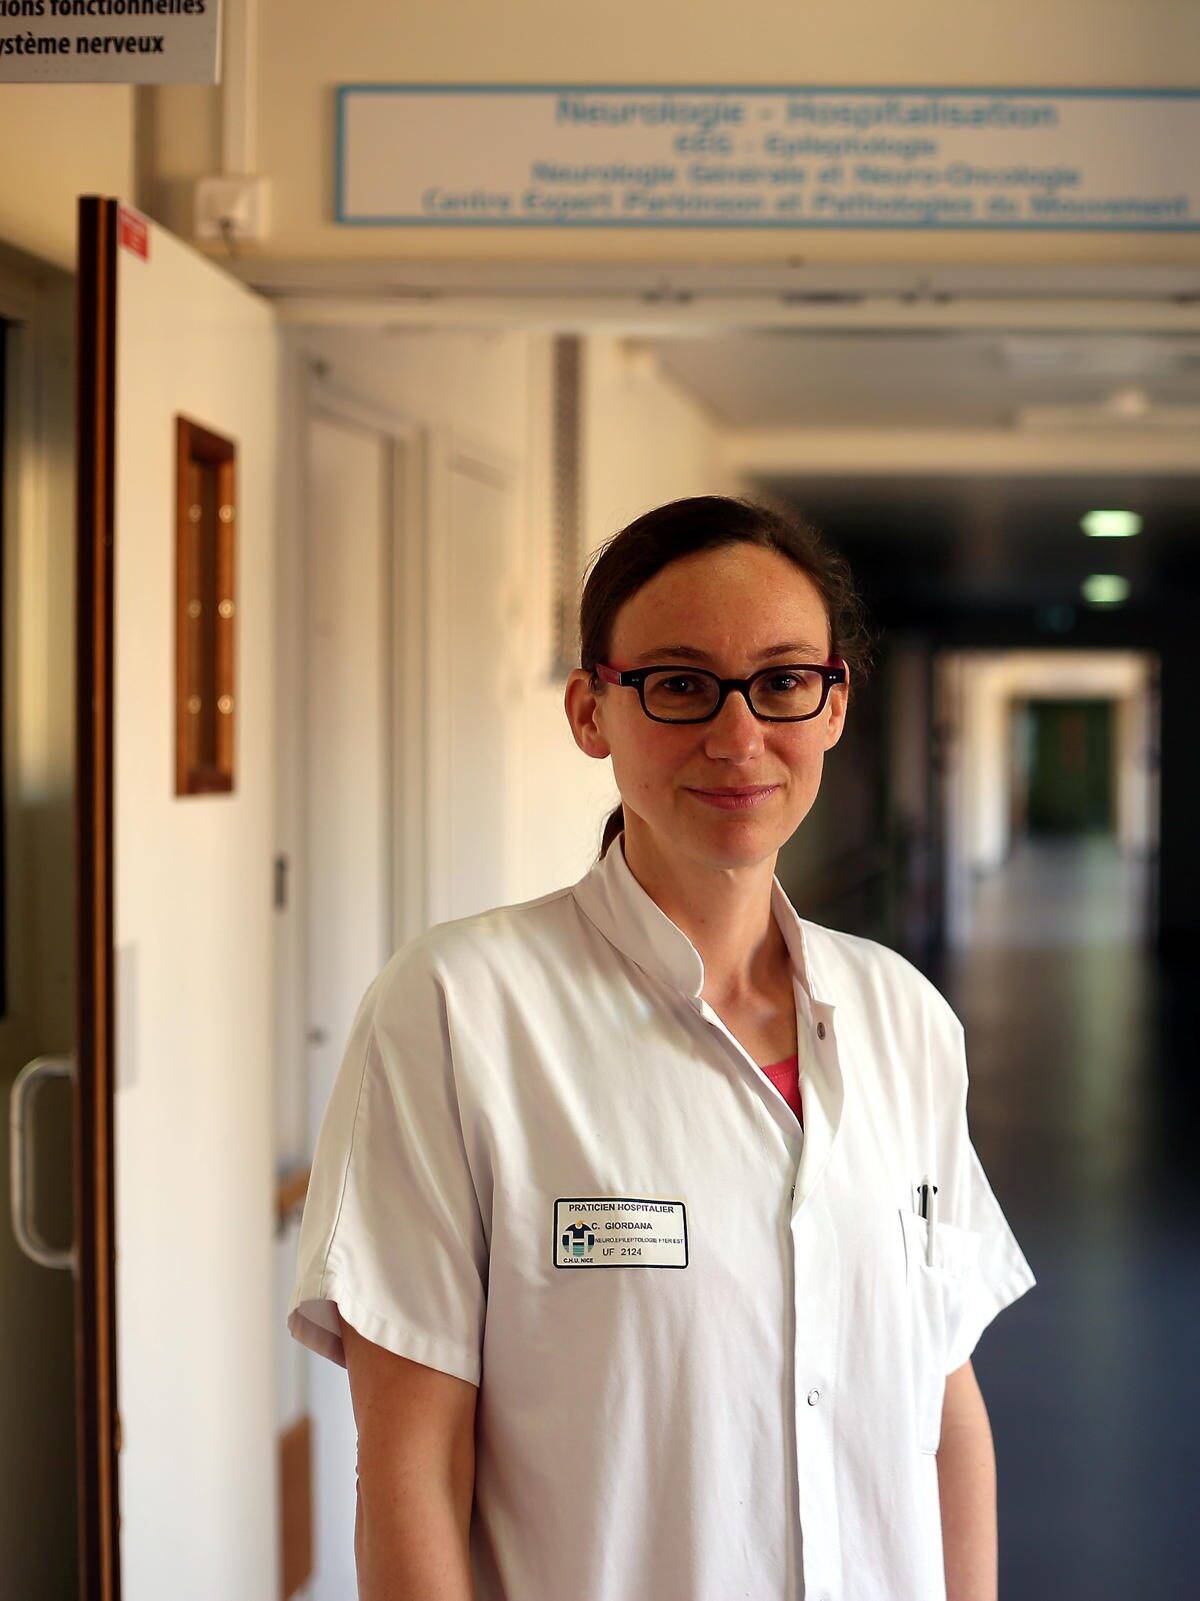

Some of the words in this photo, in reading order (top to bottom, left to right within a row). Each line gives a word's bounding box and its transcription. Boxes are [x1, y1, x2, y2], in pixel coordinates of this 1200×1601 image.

[0, 0, 45, 16] ions
[76, 36, 164, 53] nerveux
[555, 97, 748, 131] Neurologie
[787, 98, 1058, 130] Hospitalisation
[532, 161, 680, 190] Neurologie
[568, 1203, 616, 1212] PRATICIEN
[617, 1203, 675, 1214] HOSPITALIER
[591, 1222, 600, 1230] C.
[605, 1222, 653, 1231] GIORDANA
[602, 1248, 615, 1256] UF
[620, 1248, 642, 1256] 2124
